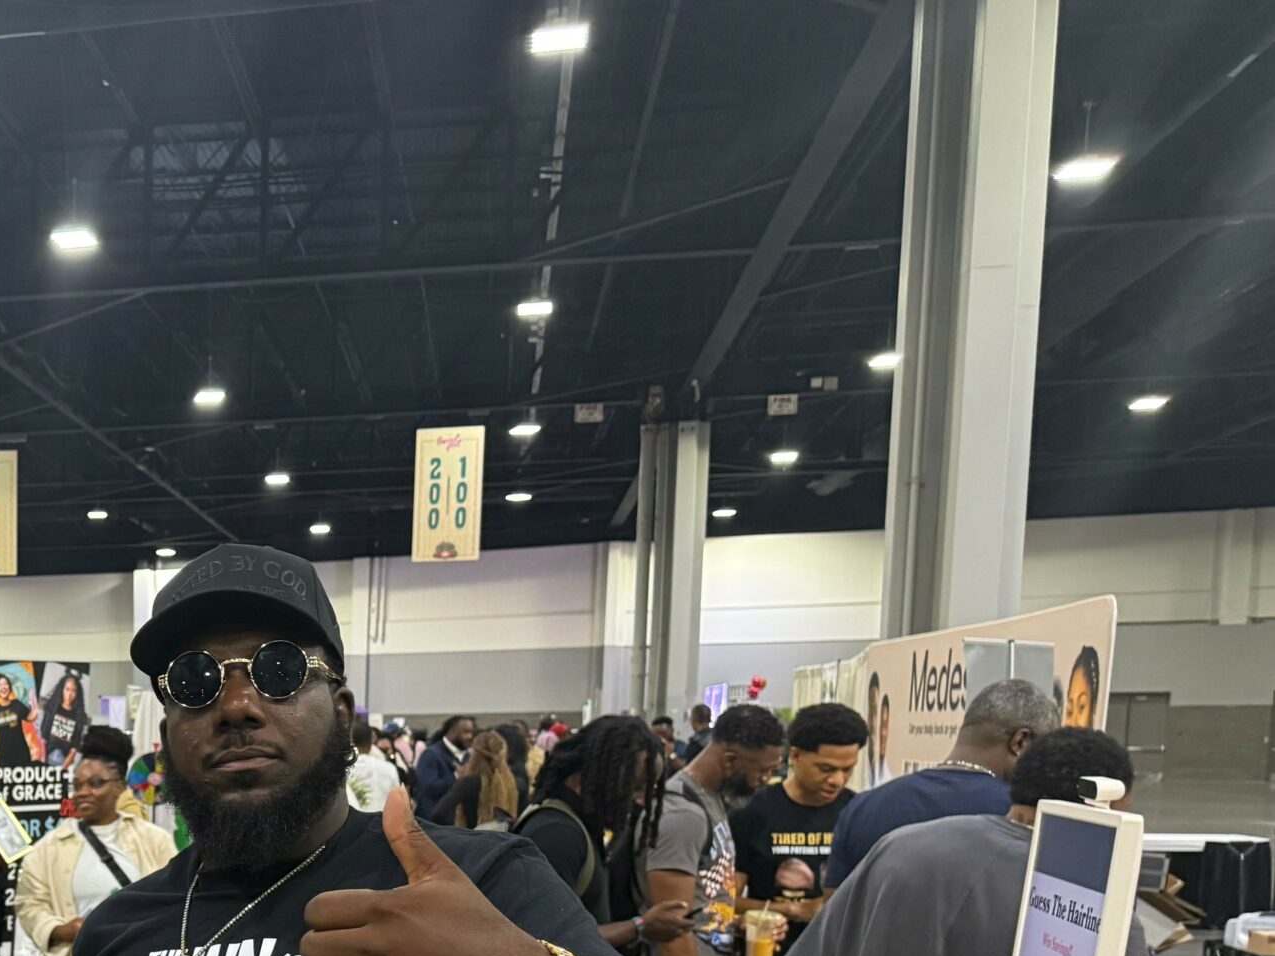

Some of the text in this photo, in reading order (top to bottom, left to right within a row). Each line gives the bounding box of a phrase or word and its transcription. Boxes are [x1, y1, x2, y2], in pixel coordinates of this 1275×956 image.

[12, 783, 63, 801] GRACE
[1029, 886, 1051, 914] Guess
[1052, 894, 1067, 920] The
